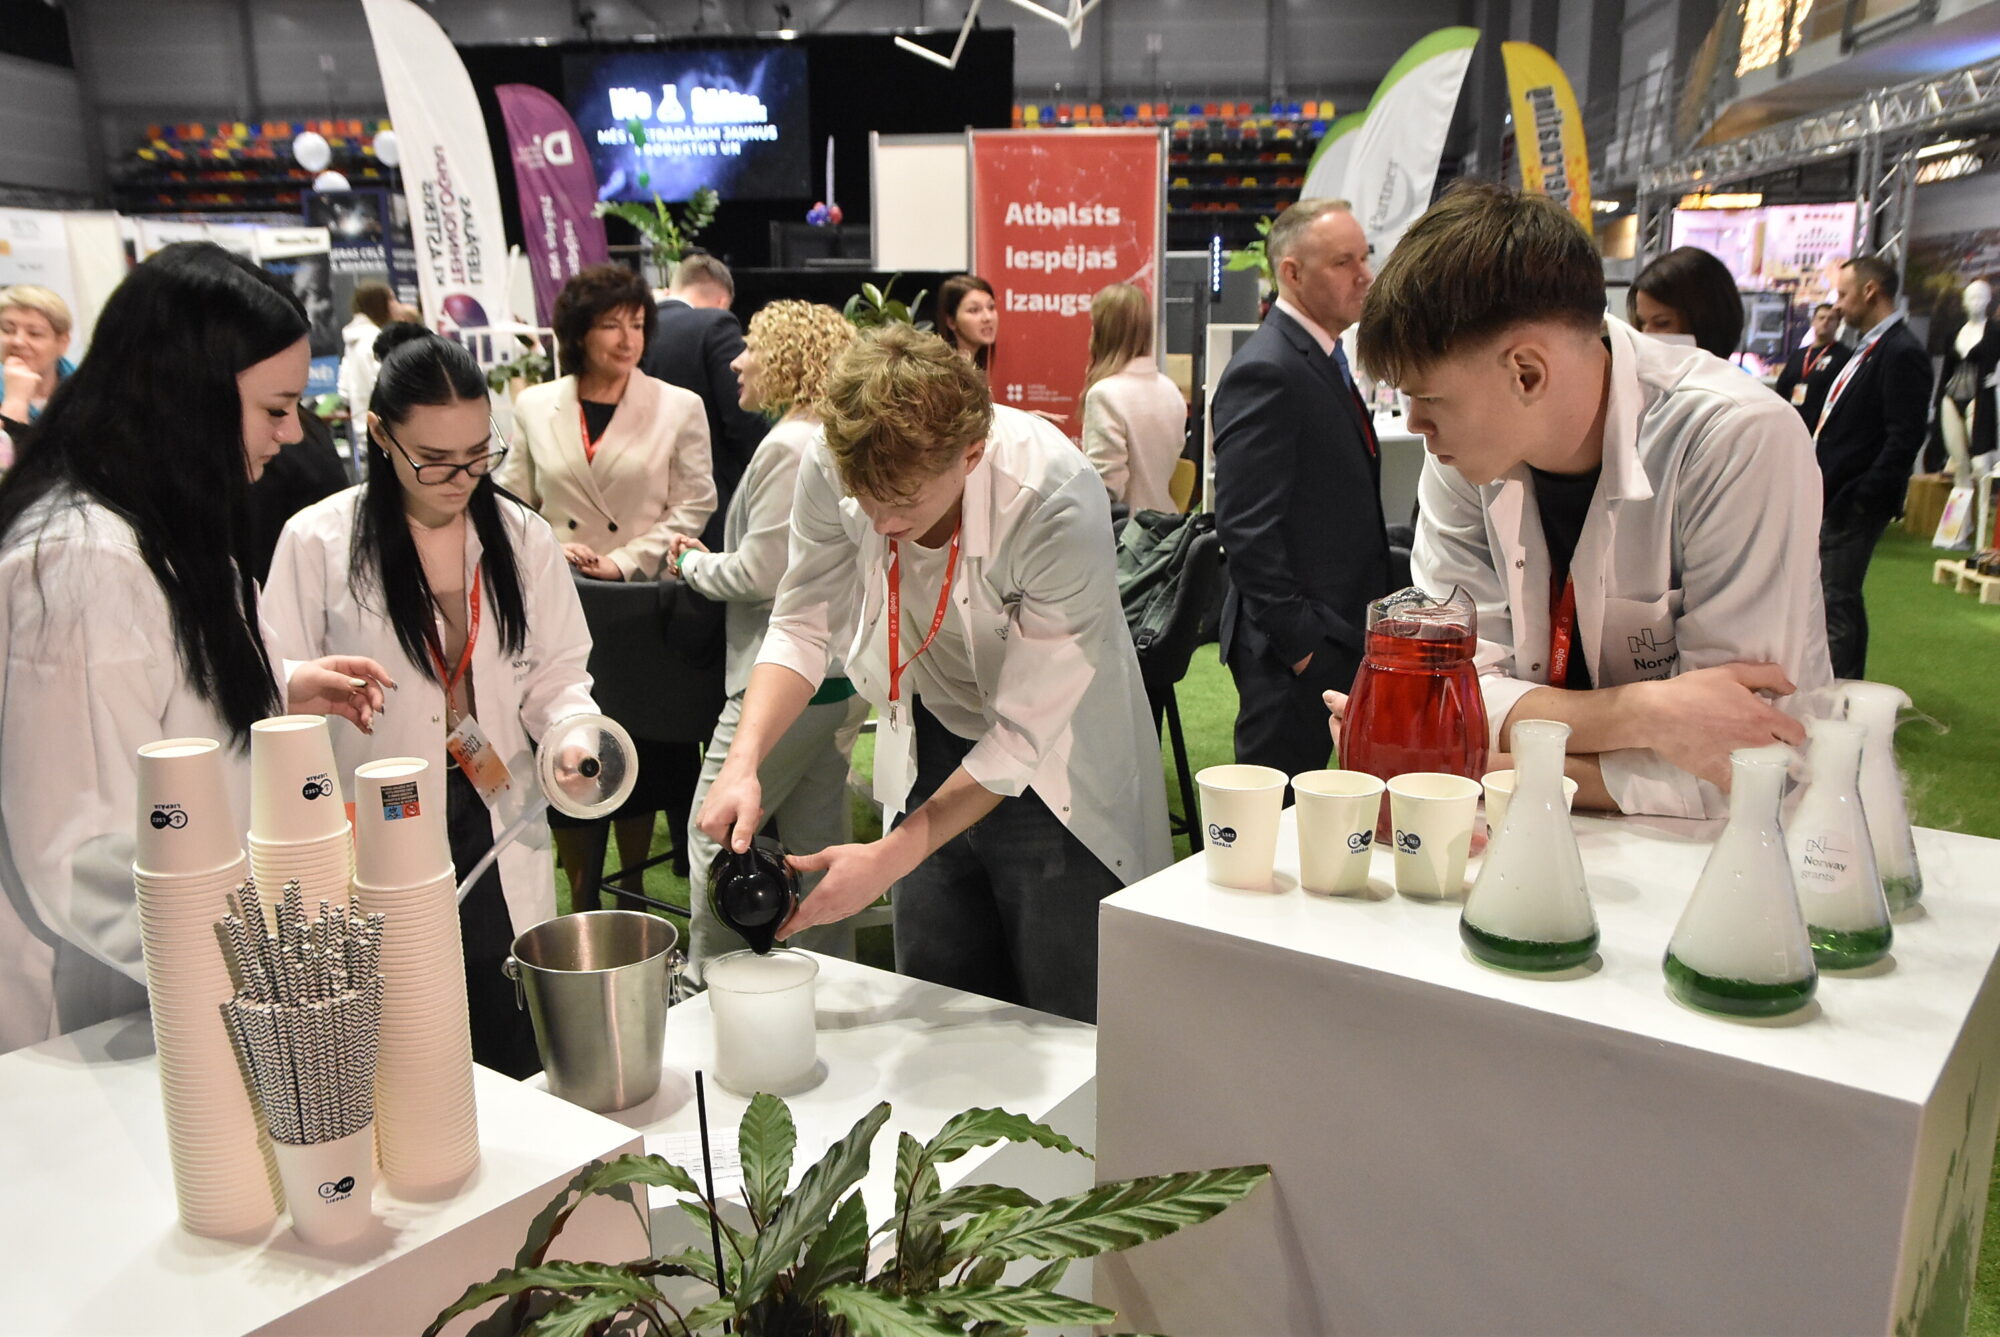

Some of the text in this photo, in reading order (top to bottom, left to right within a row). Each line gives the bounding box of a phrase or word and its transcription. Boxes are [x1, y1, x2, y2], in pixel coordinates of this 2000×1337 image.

[1005, 201, 1121, 227] Atbalsts
[1005, 244, 1118, 275] Iespējas
[1005, 288, 1092, 317] Izaugs
[1633, 651, 1680, 671] Norw
[1803, 855, 1848, 873] Norway
[1801, 870, 1836, 882] grants
